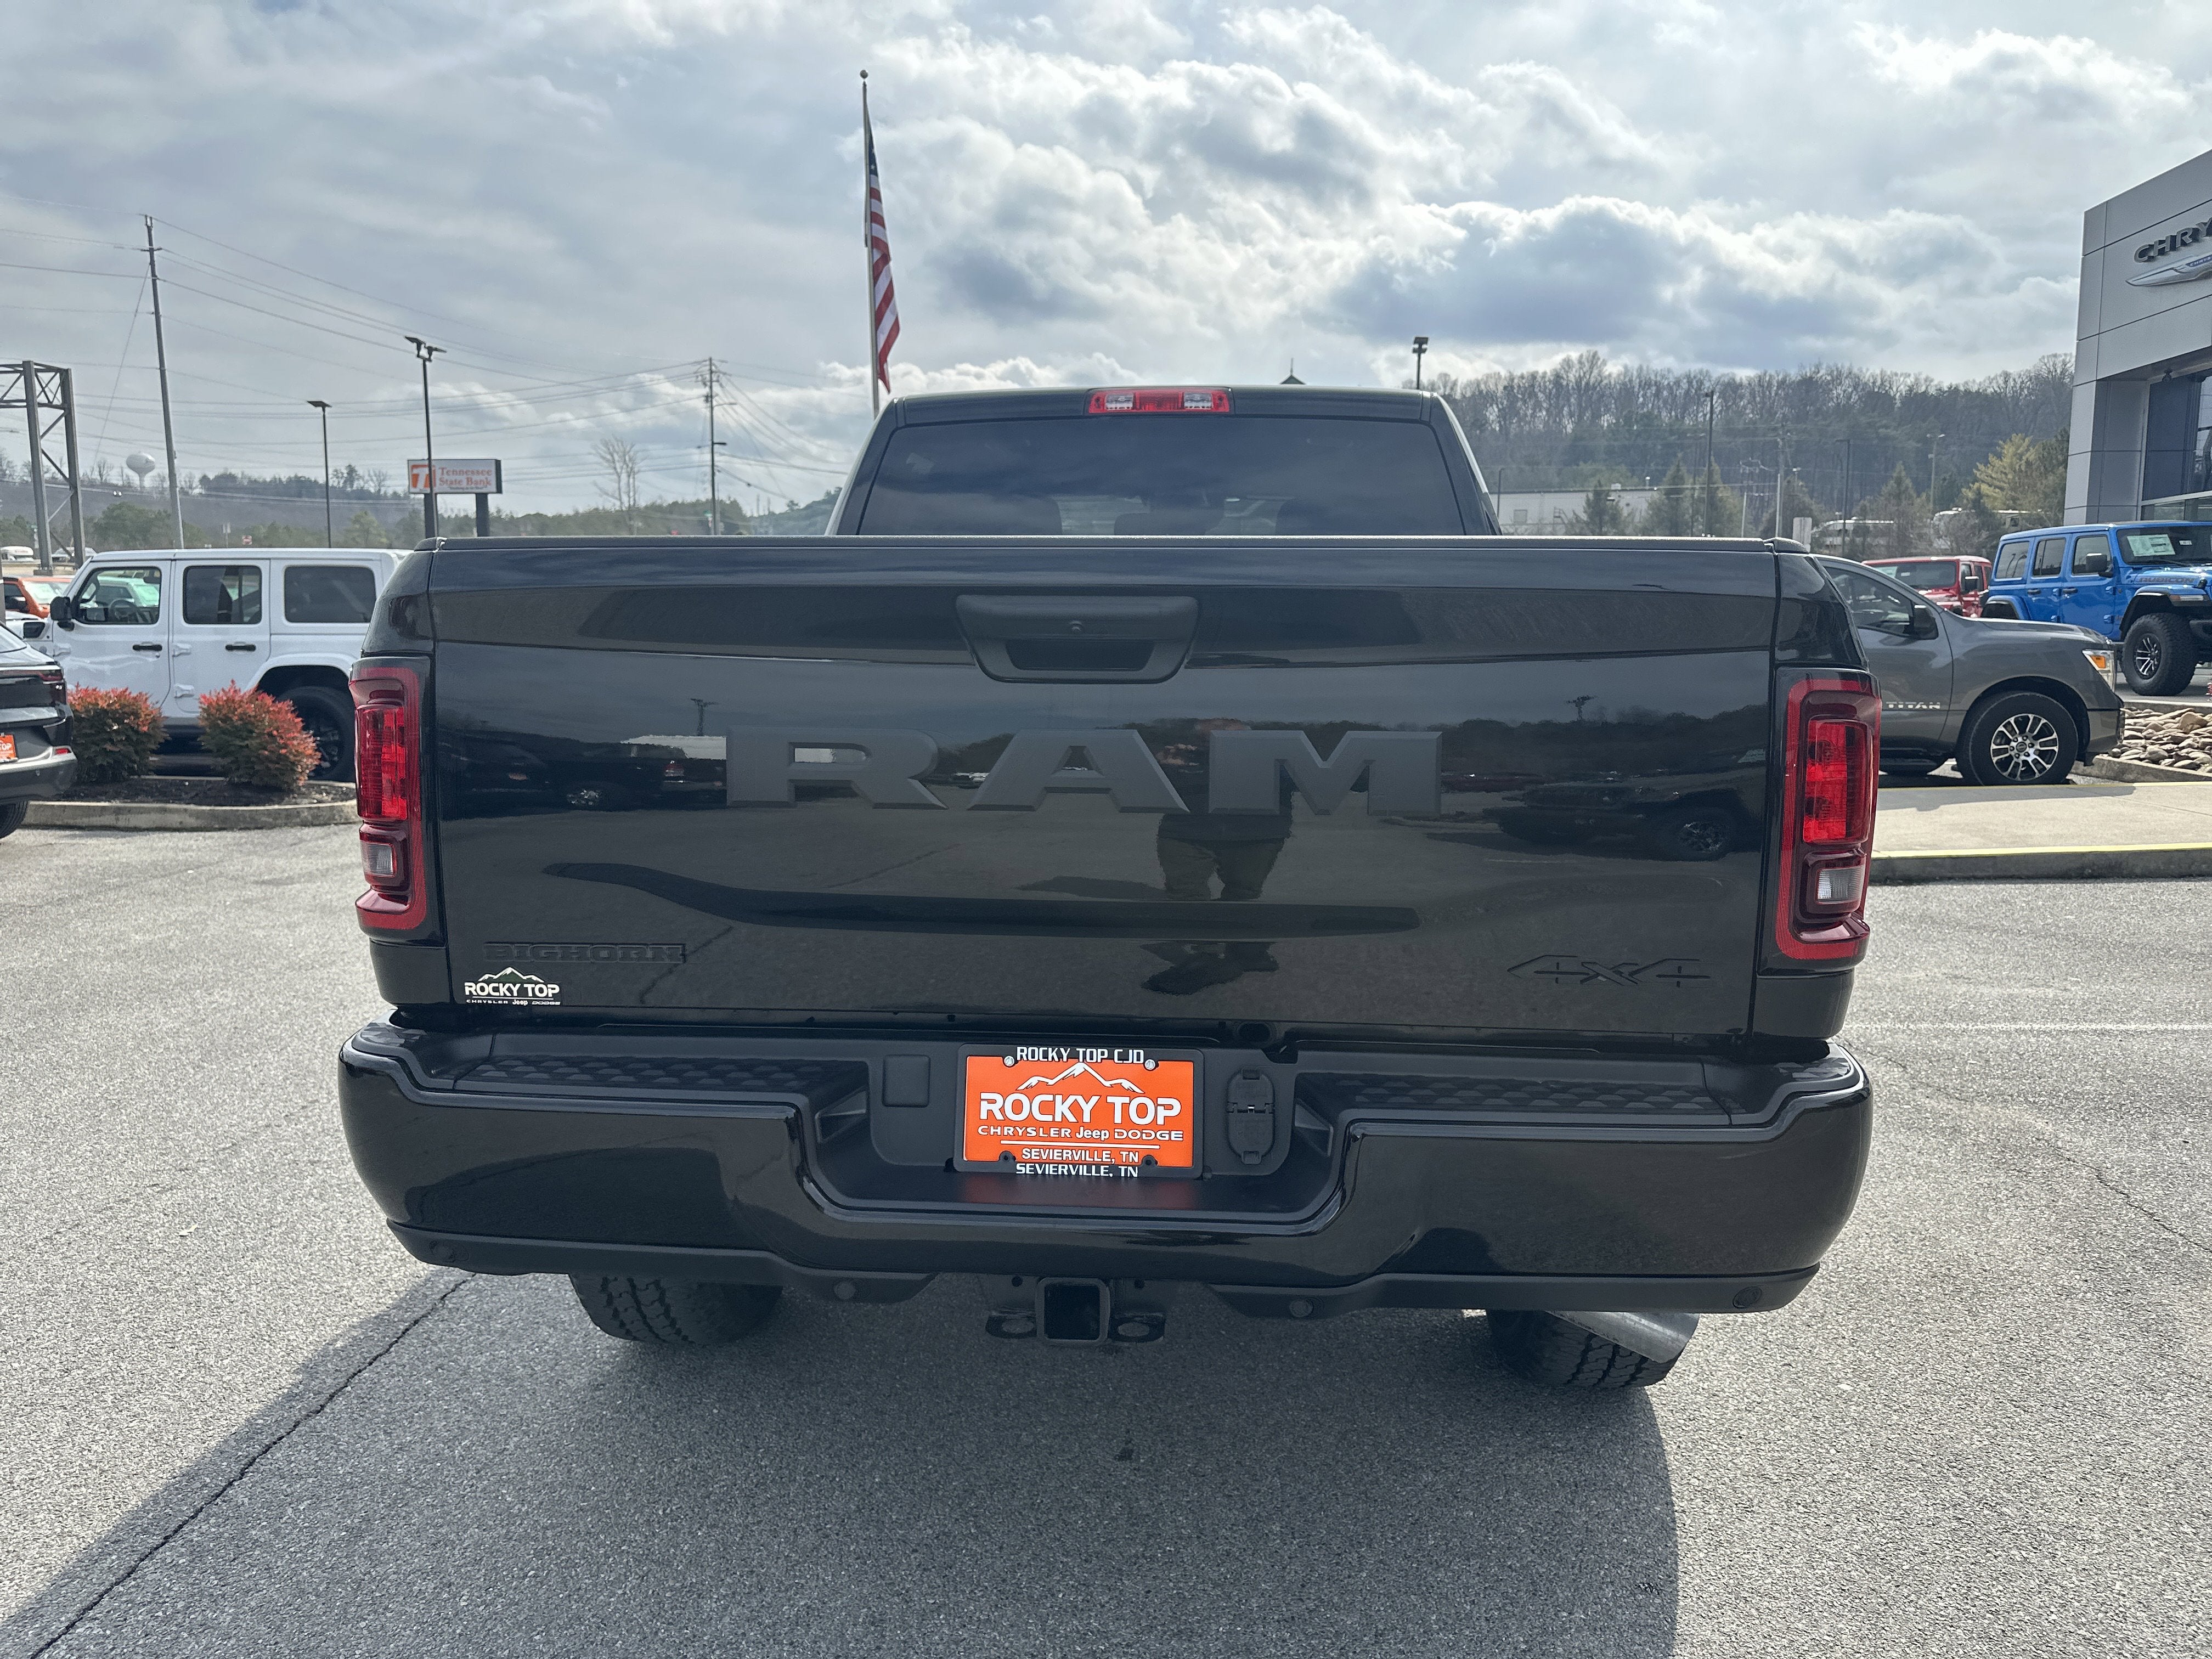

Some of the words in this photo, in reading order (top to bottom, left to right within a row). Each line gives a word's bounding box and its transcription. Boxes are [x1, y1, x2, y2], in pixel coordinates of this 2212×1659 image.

[439, 467, 492, 476] Tennessee
[439, 476, 463, 486] State
[465, 476, 492, 486] Bank
[726, 728, 1443, 816] RAM
[464, 982, 521, 996] ROCKY
[523, 984, 560, 997] TOP
[1017, 1046, 1070, 1062] ROCKY
[1076, 1048, 1108, 1063] TOP
[1114, 1049, 1144, 1064] CJD
[979, 1092, 1101, 1124] ROCKY
[1107, 1096, 1182, 1125] TOP
[977, 1125, 1072, 1138] CHRYSLER
[1075, 1126, 1110, 1141] Jeep
[1114, 1128, 1184, 1142] DODGE
[1022, 1147, 1116, 1164] SEVIERVILLE,
[1120, 1151, 1139, 1164] TN
[1119, 1166, 1138, 1178] TN
